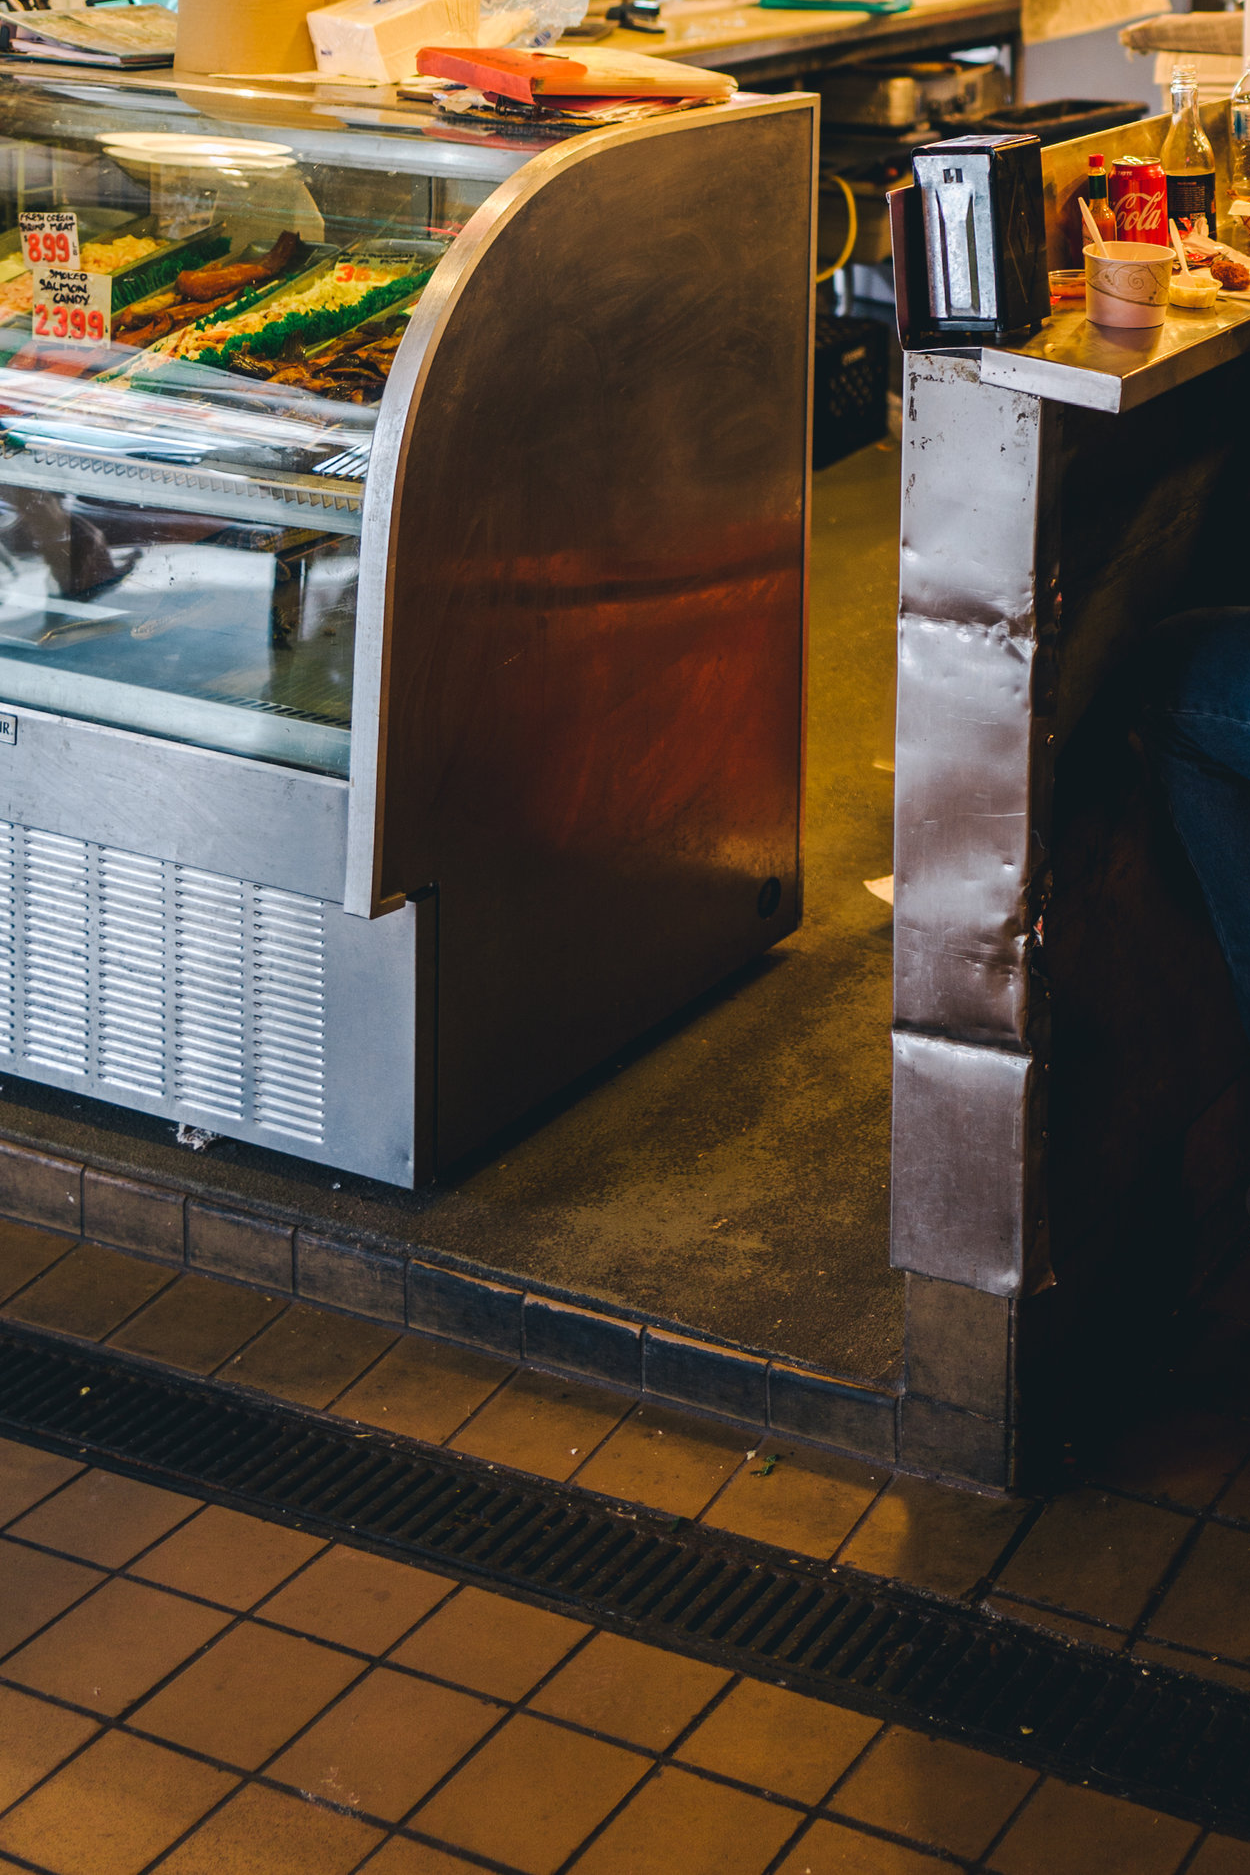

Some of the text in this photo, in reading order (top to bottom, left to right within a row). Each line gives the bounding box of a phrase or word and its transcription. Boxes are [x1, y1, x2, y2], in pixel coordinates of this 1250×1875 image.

[1115, 189, 1165, 231] Cola
[49, 269, 88, 282] SMOKED
[39, 279, 88, 294] SALMON
[53, 293, 91, 306] CANDY
